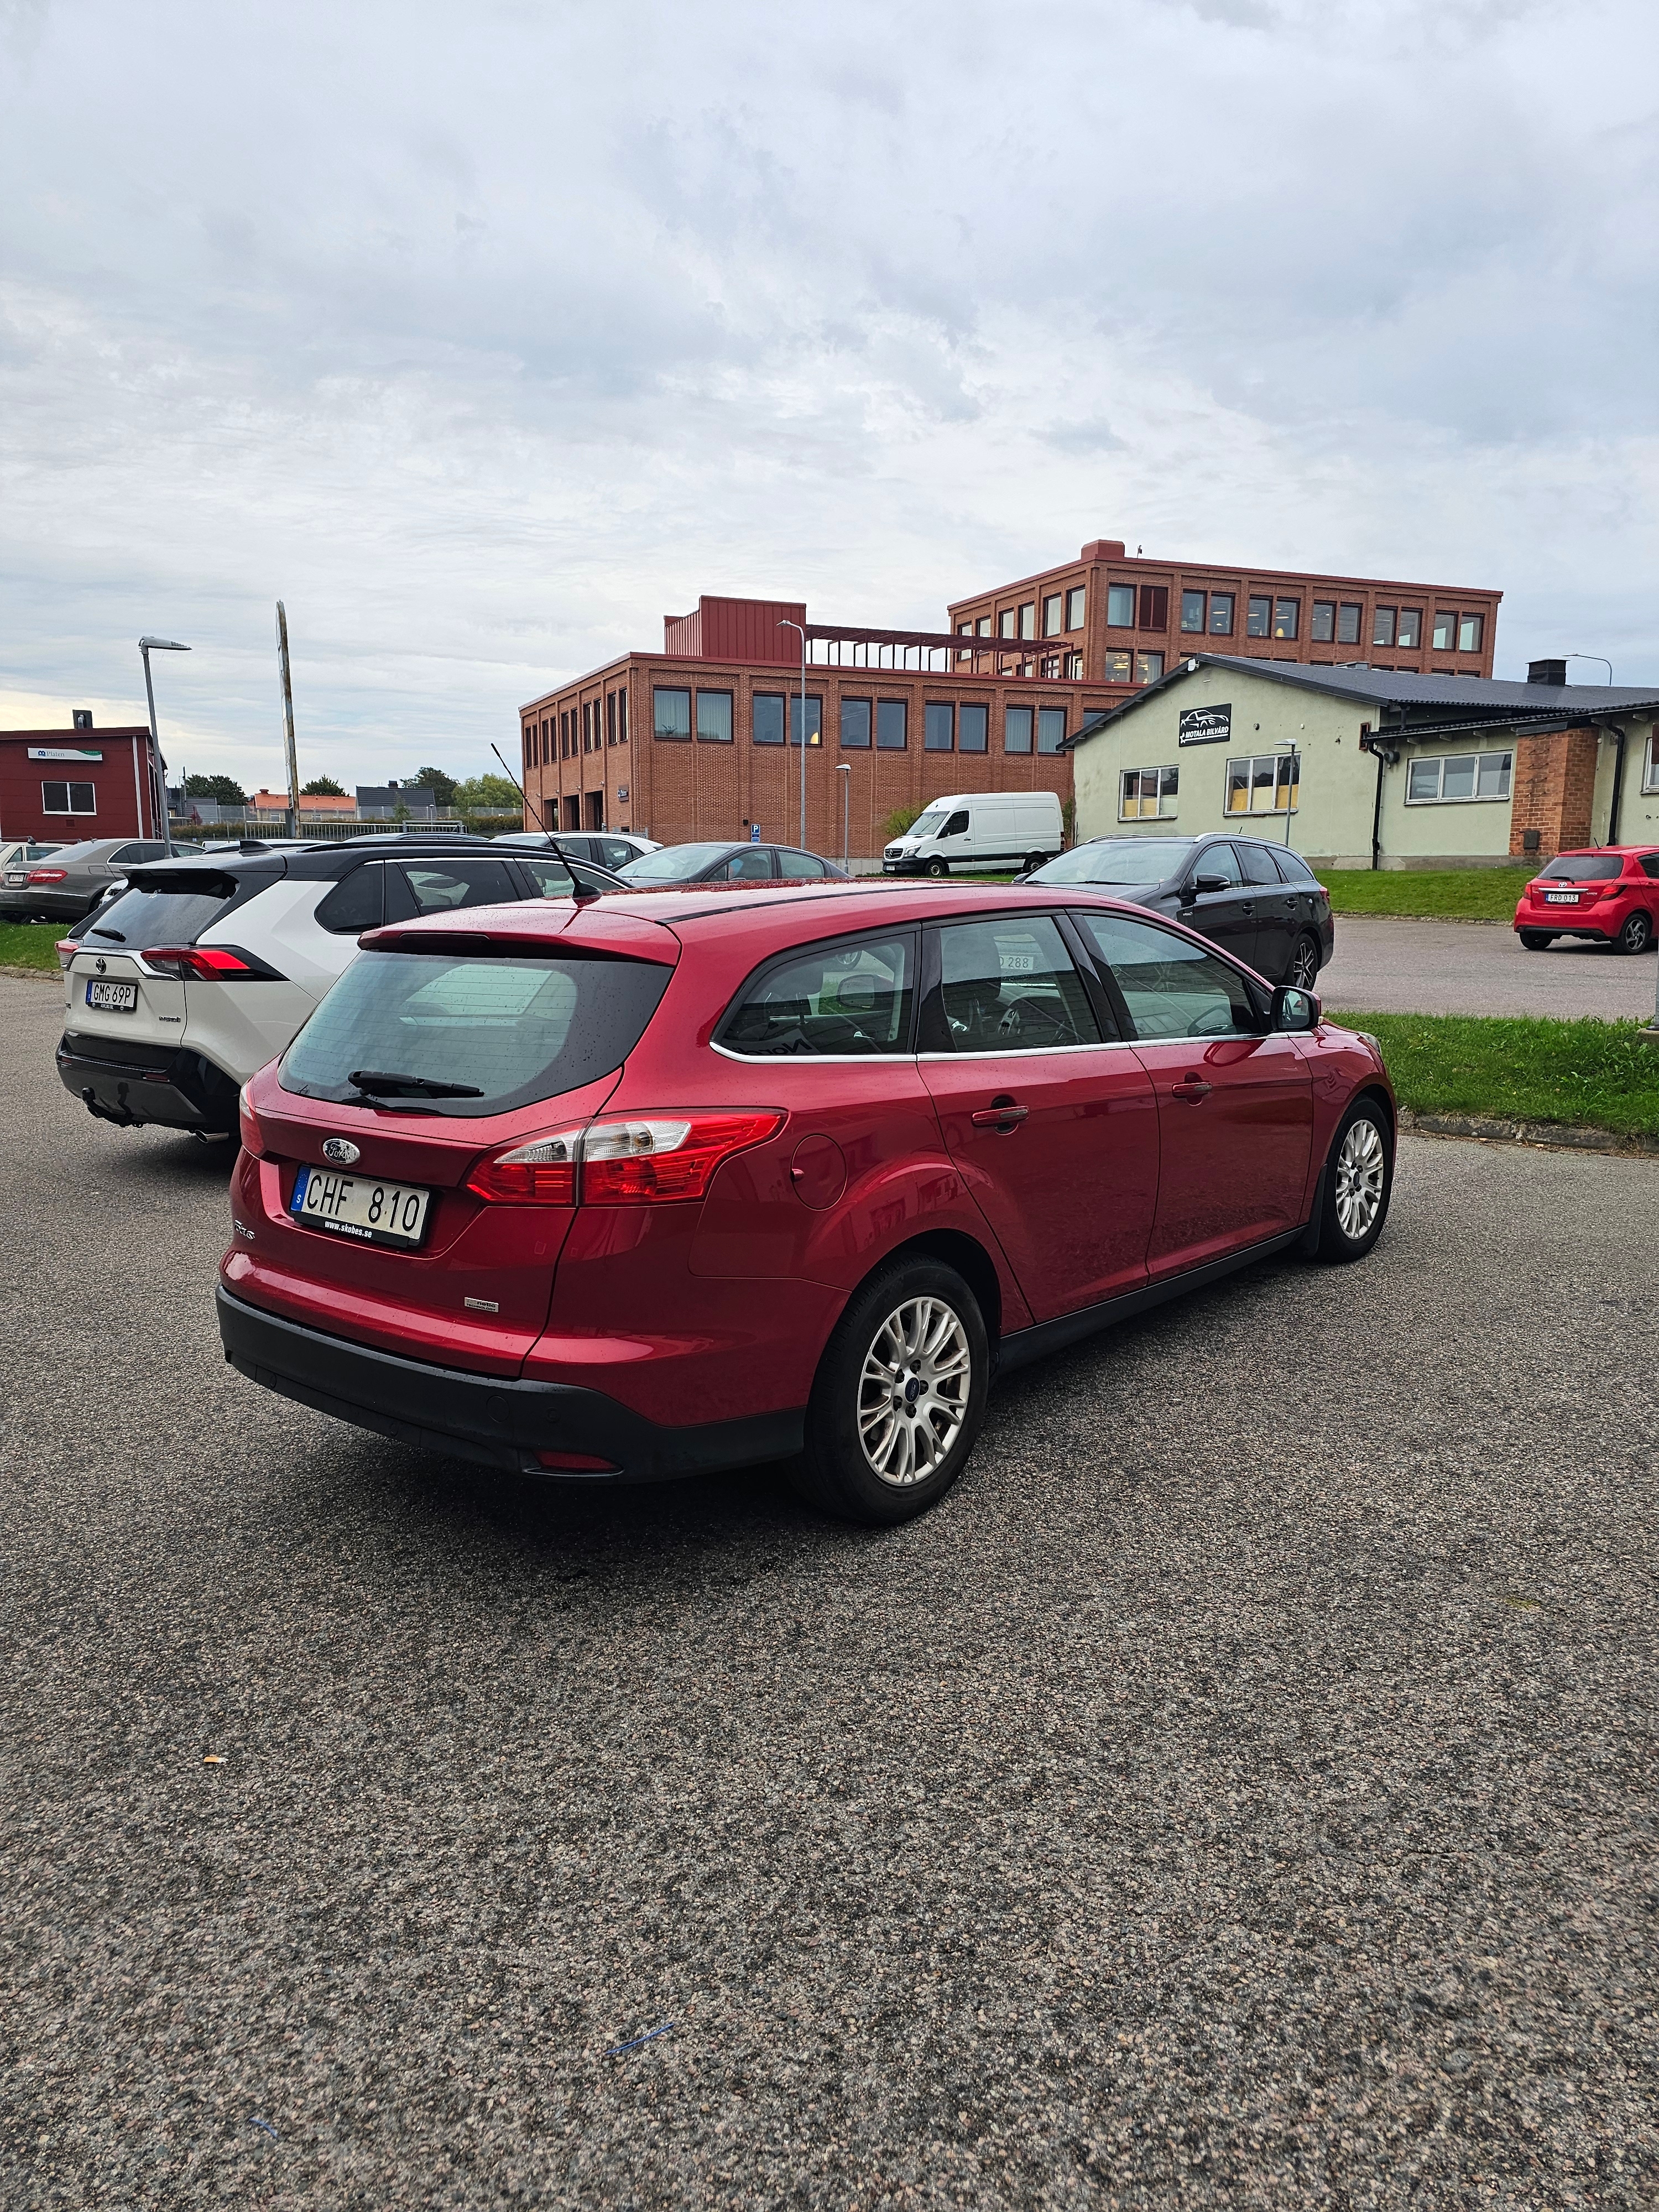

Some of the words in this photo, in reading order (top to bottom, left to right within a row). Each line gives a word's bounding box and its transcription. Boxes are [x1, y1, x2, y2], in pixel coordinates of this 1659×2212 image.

[1185, 729, 1206, 738] MOTALA
[1207, 726, 1229, 735] BILVÅRD
[1008, 957, 1029, 968] 288
[94, 984, 110, 1002] GMG
[112, 986, 131, 1004] 69P
[296, 1194, 302, 1204] S
[307, 1175, 353, 1215] CHF
[368, 1187, 420, 1232] 810
[325, 1220, 372, 1239] www.skobes.se
[466, 1303, 496, 1311] TECHNOLOGY
